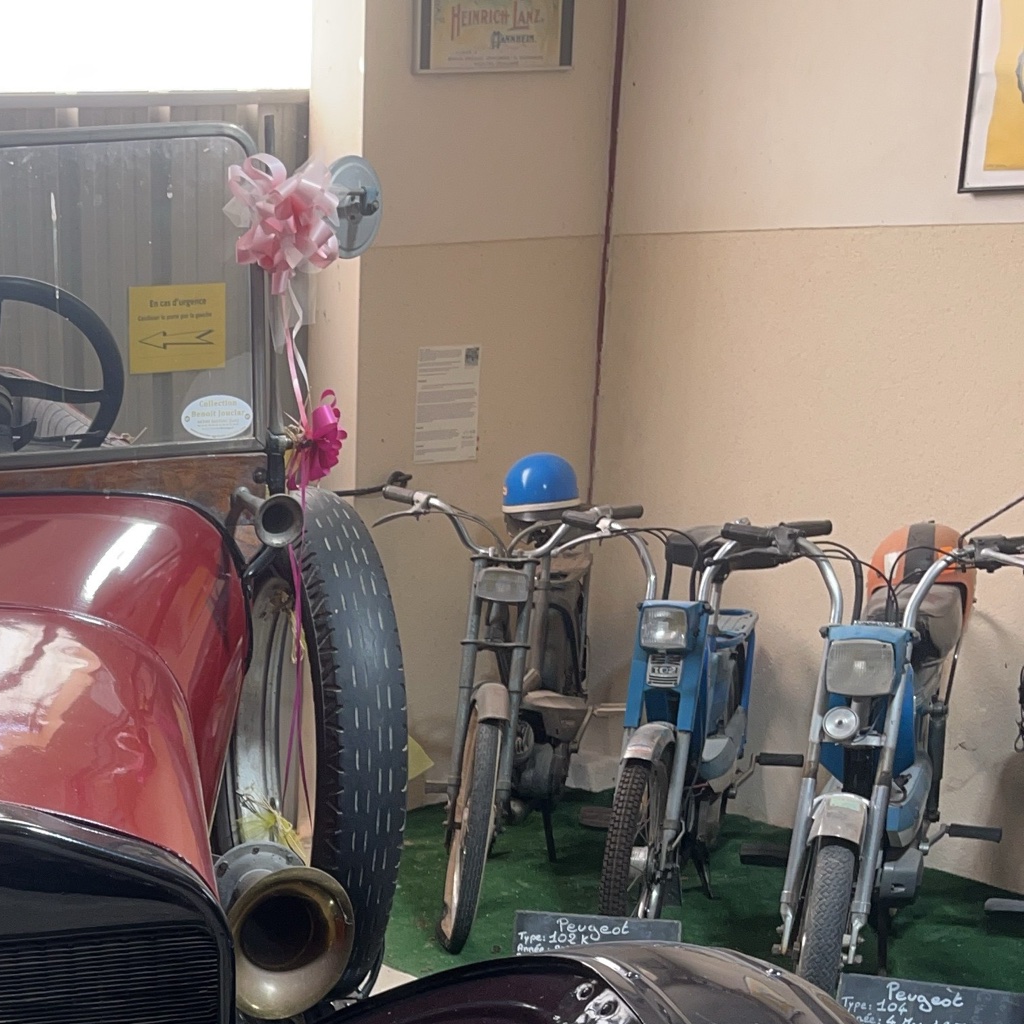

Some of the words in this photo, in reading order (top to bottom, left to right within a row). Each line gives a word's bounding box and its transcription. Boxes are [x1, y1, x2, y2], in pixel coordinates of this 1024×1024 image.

[149, 300, 159, 308] En
[172, 298, 207, 308] d'urgence
[518, 931, 546, 945] Type:
[549, 931, 576, 945] 102
[556, 917, 630, 941] Peugeot
[841, 996, 872, 1013] Type:
[877, 999, 908, 1015] 104
[886, 981, 964, 1012] Peugeot
